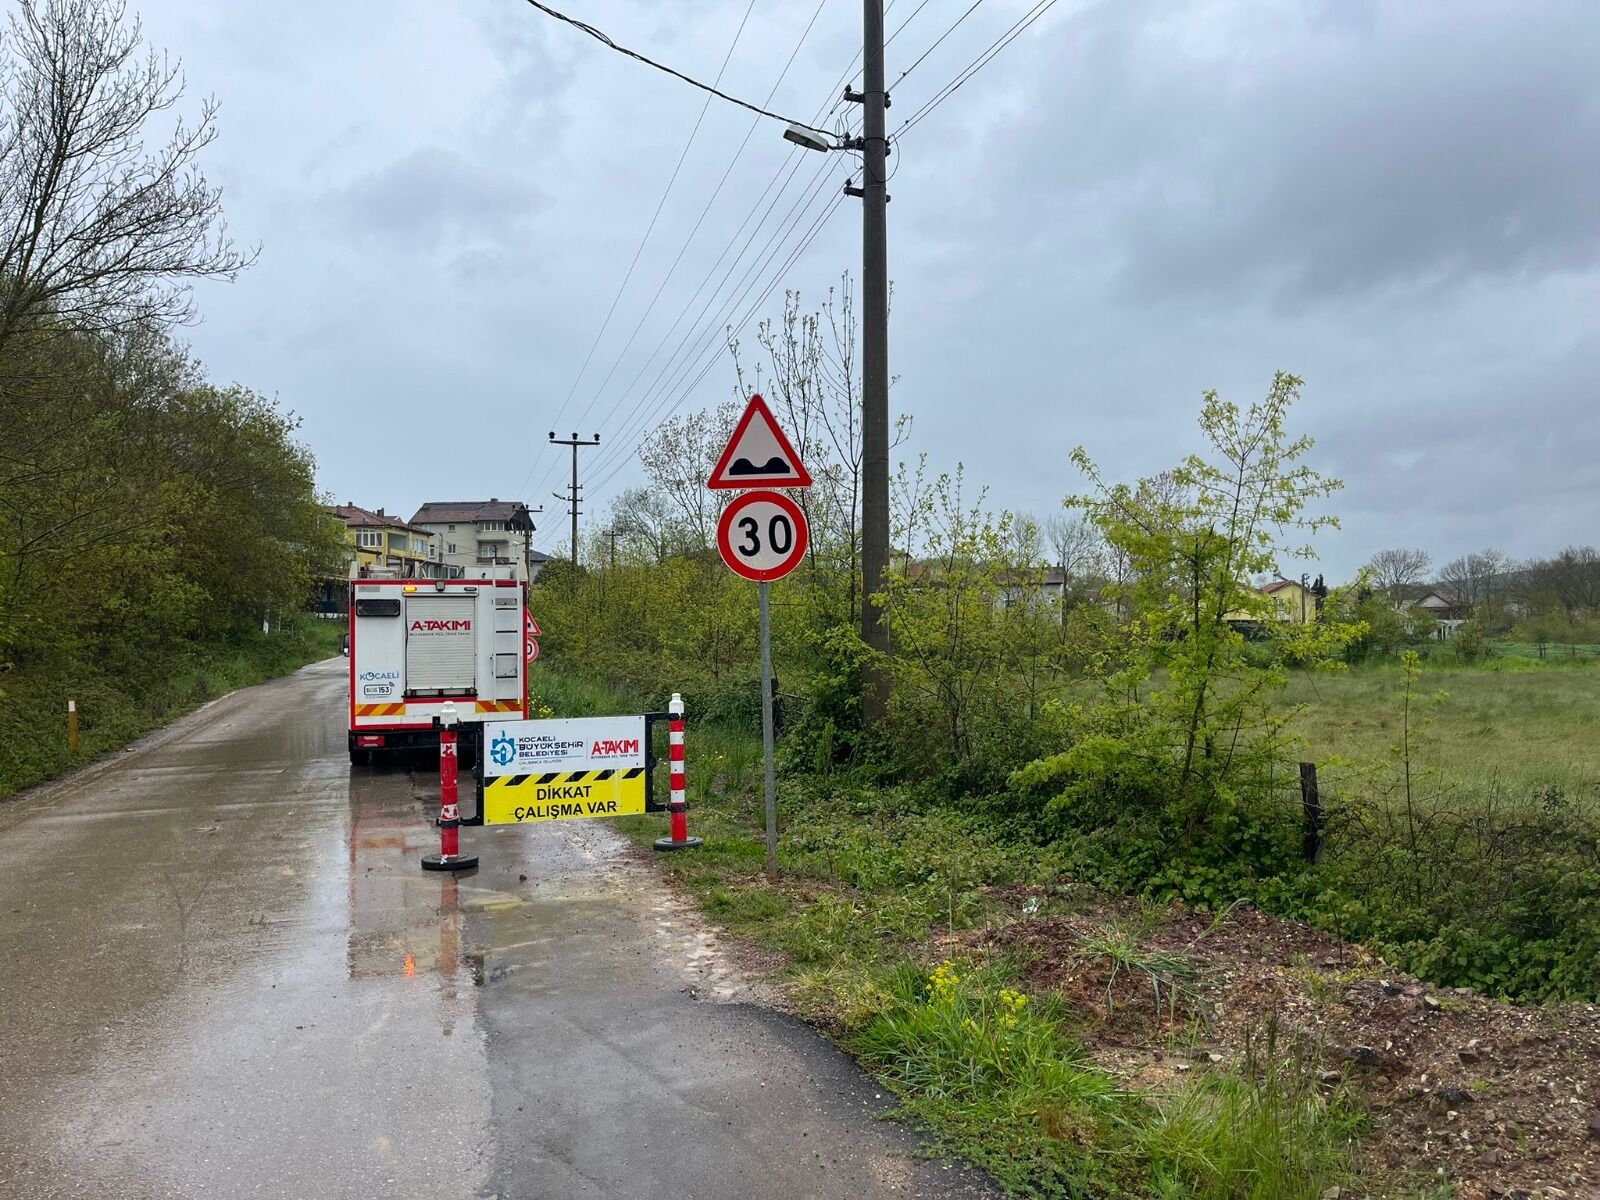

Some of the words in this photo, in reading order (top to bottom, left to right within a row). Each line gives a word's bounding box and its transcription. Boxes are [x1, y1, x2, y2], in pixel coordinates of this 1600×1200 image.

[738, 514, 792, 557] 30
[411, 620, 471, 631] A-TAKIMI
[360, 671, 400, 681] KOCAELİ
[378, 686, 390, 694] 153
[518, 741, 584, 751] BÜYÜKŞEHİR
[591, 739, 639, 755] A-TAKIMI
[518, 750, 568, 758] BELEDİYESİ
[536, 785, 592, 801] DİKKAT
[514, 803, 583, 821] ÇALIŞMA
[587, 800, 617, 813] VAR
